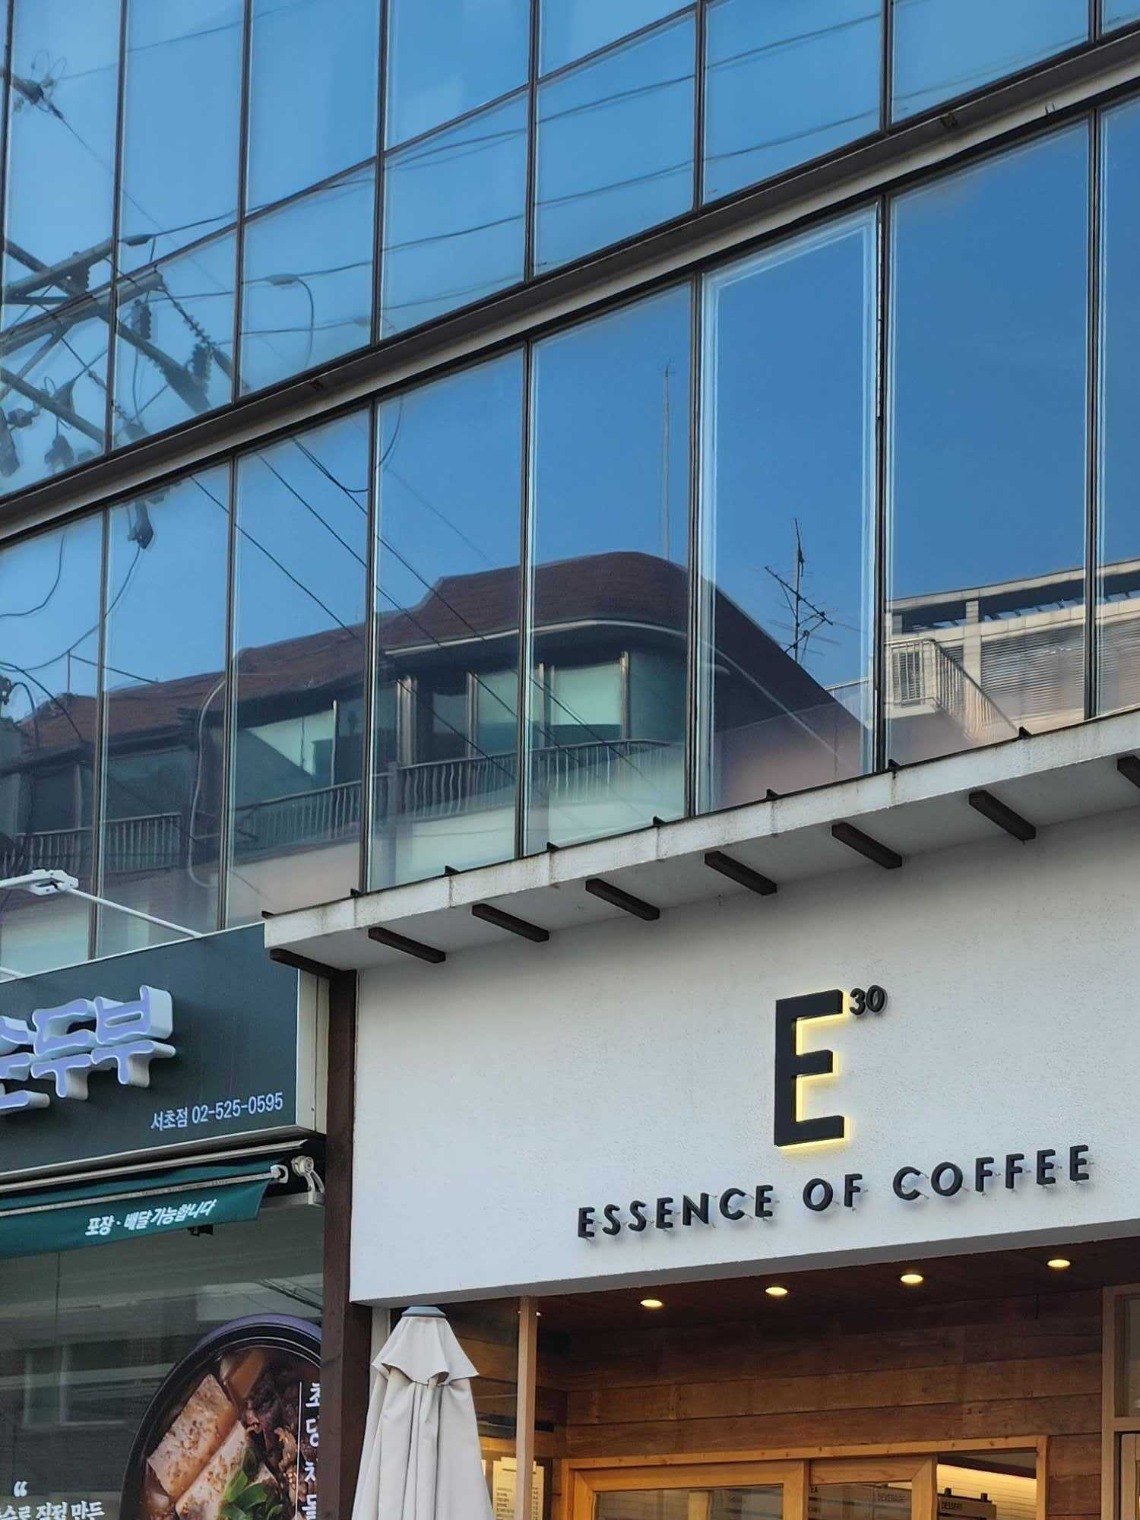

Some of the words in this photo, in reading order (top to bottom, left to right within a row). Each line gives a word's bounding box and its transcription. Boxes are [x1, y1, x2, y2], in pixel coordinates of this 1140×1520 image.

[151, 1107, 188, 1131] 서초점
[191, 1092, 284, 1124] 02-525-0595
[577, 1184, 774, 1239] ESSENCE
[802, 1173, 864, 1212] OF
[892, 1144, 1090, 1202] COFFEE
[85, 1215, 115, 1236] 포장
